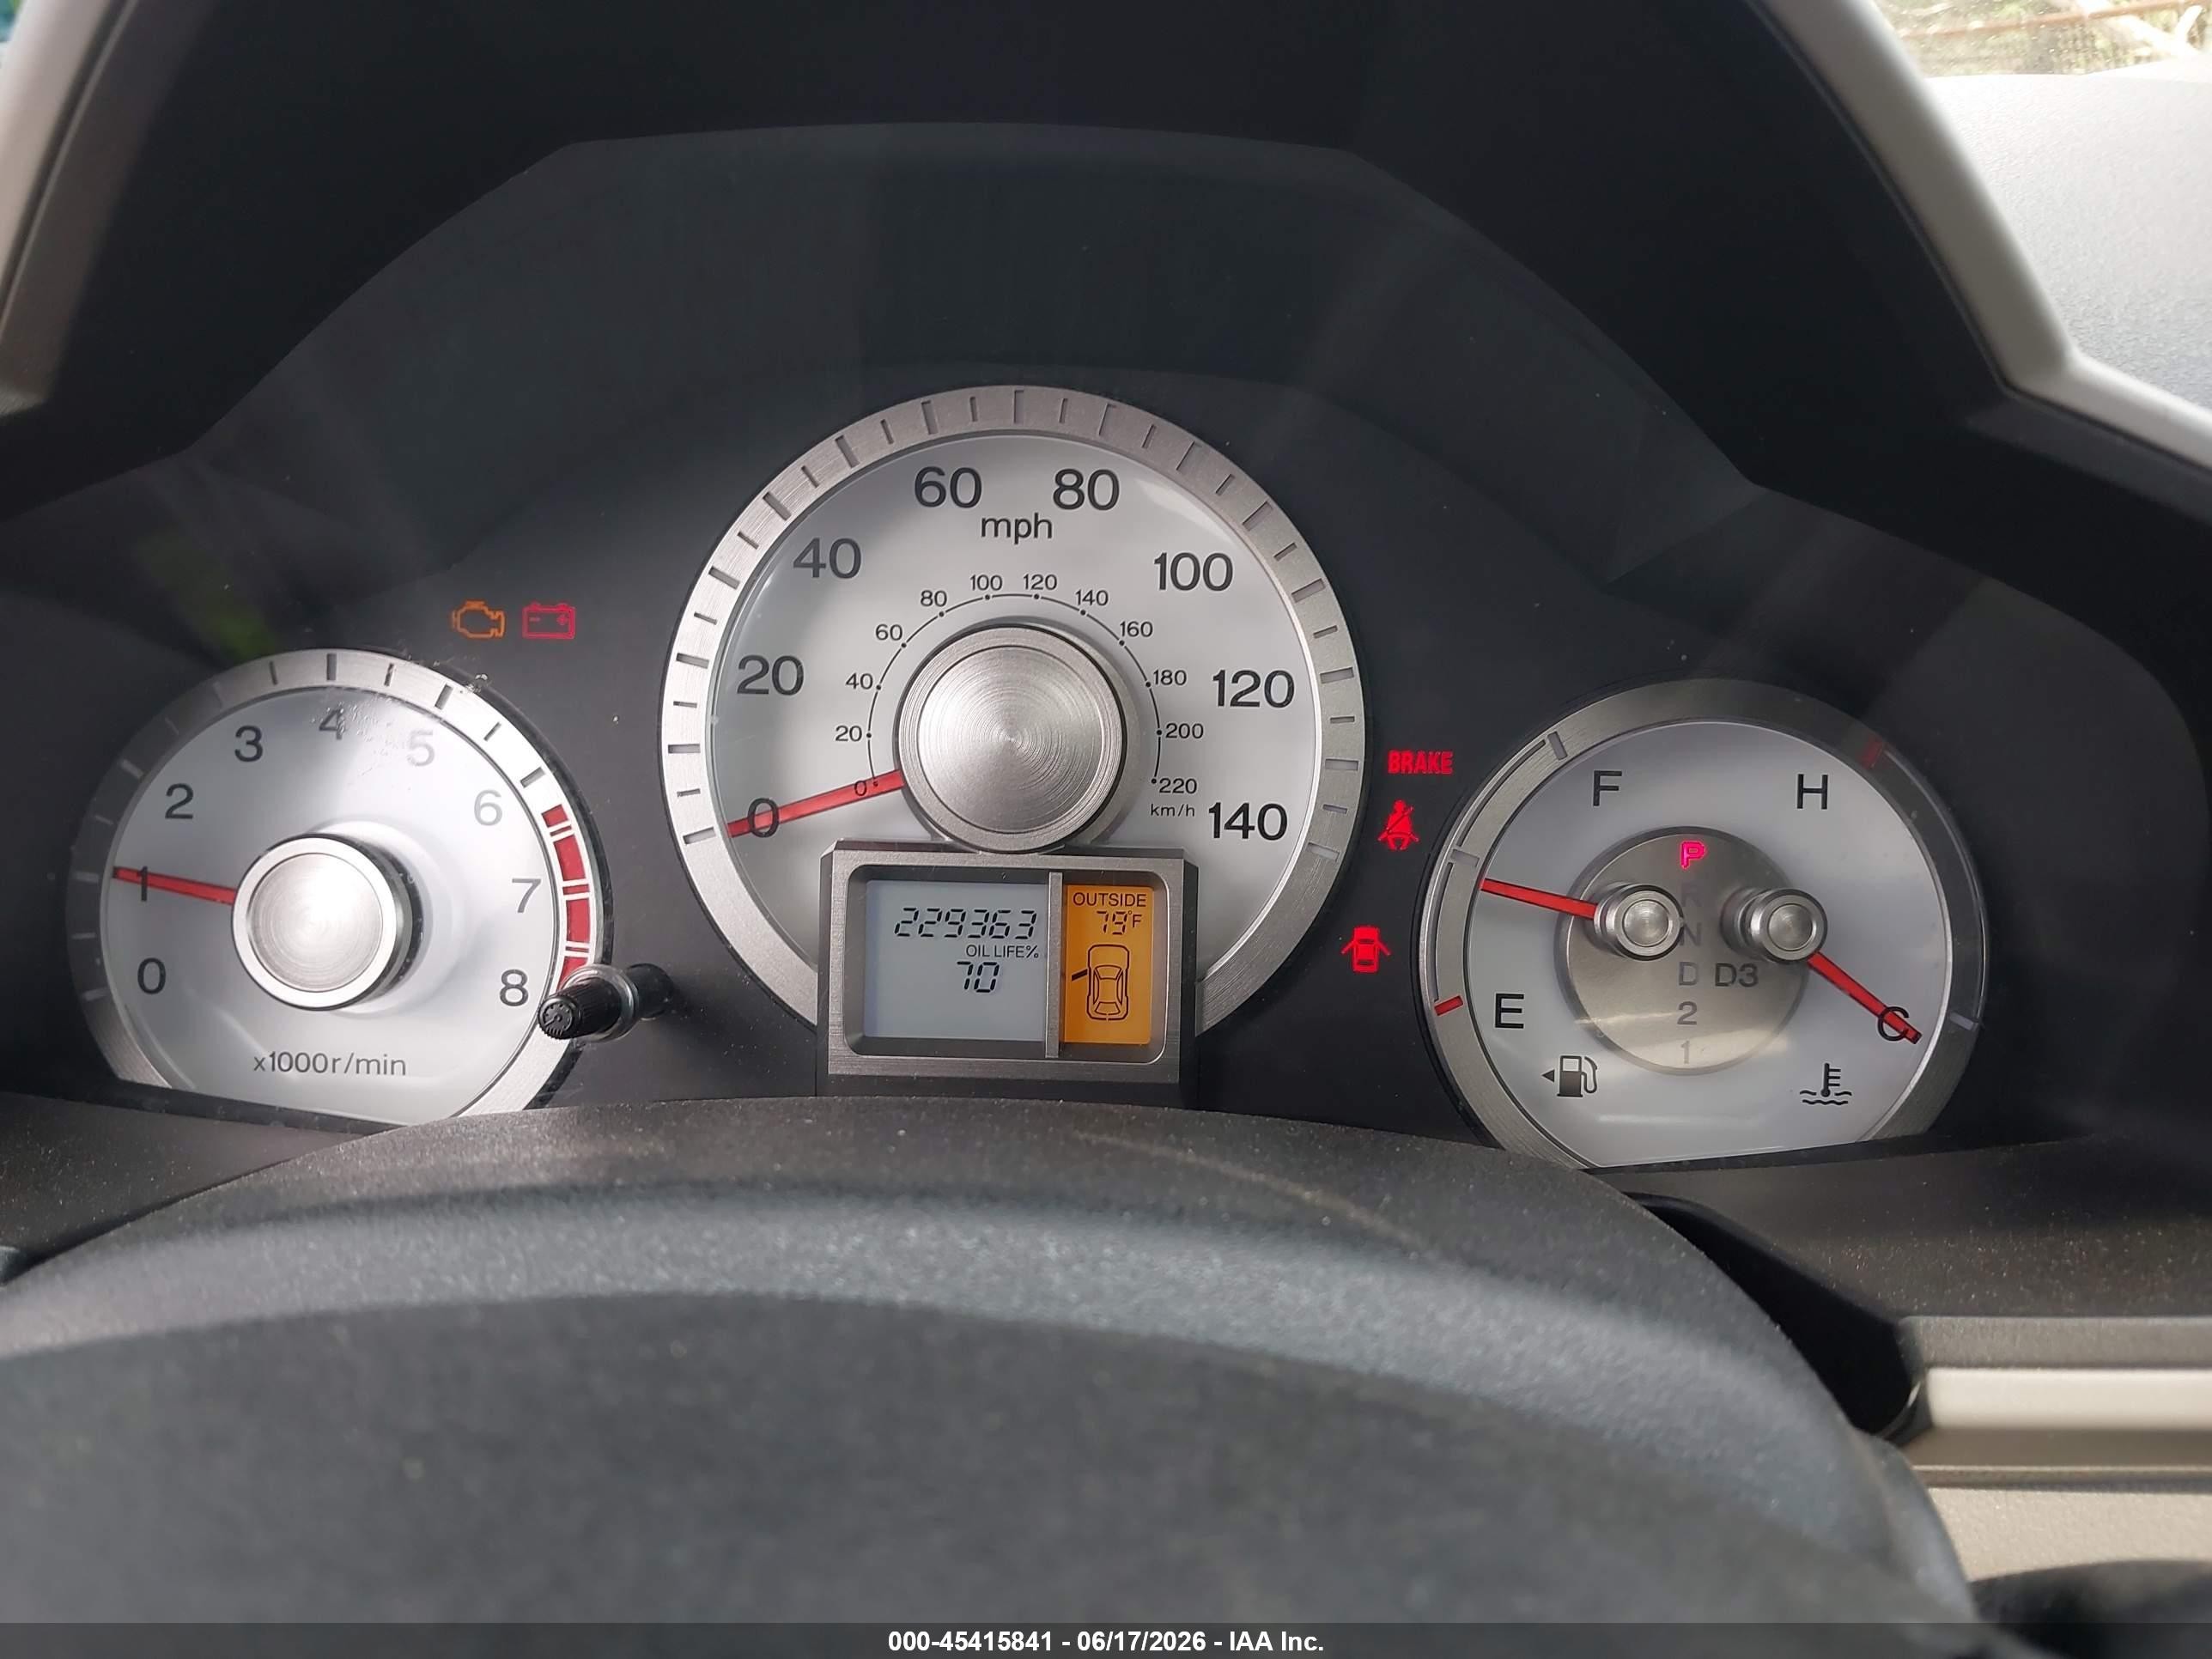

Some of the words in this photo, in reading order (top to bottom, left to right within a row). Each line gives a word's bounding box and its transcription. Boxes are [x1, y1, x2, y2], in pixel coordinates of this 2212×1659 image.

[915, 467, 982, 508] 60
[1053, 470, 1121, 510] 80
[981, 513, 1053, 544] mph
[793, 538, 862, 578] 40
[1154, 552, 1233, 592] 100
[970, 574, 1003, 592] 100
[1023, 574, 1058, 592] 120
[1075, 590, 1109, 607] 140
[921, 590, 948, 608] 80
[875, 623, 902, 641] 60
[1119, 621, 1153, 639] 160
[738, 655, 805, 695] 20
[846, 672, 873, 690] 40
[1152, 669, 1188, 687] 180
[1212, 670, 1294, 708] 120
[319, 708, 347, 741] 4
[835, 725, 863, 743] 20
[1164, 722, 1205, 740] 200
[235, 726, 264, 762] 3
[408, 730, 434, 767] 5
[1389, 750, 1453, 774] BRAKE
[165, 783, 194, 820] 2
[854, 780, 867, 797] 0
[1158, 777, 1198, 795] 220
[1593, 770, 1622, 806] F
[1796, 774, 1828, 810] H
[475, 789, 501, 826] 6
[748, 798, 780, 838] 0
[1150, 802, 1195, 818] km/h
[1209, 802, 1287, 840] 140
[1680, 842, 1705, 868] P
[137, 866, 149, 902] 1
[512, 878, 543, 914] 7
[1073, 892, 1146, 908] OUTSIDE
[894, 907, 1037, 939] 229363
[1680, 922, 1701, 945] N
[966, 945, 990, 958] OIL
[138, 957, 167, 994] 0
[500, 969, 528, 1006] 8
[957, 961, 1000, 993] 70
[1678, 962, 1698, 986] D
[1716, 963, 1759, 987] D3
[1496, 994, 1524, 1030] E
[1677, 1001, 1698, 1025] 2
[1878, 1006, 1910, 1042] C
[1680, 1040, 1690, 1064] 1
